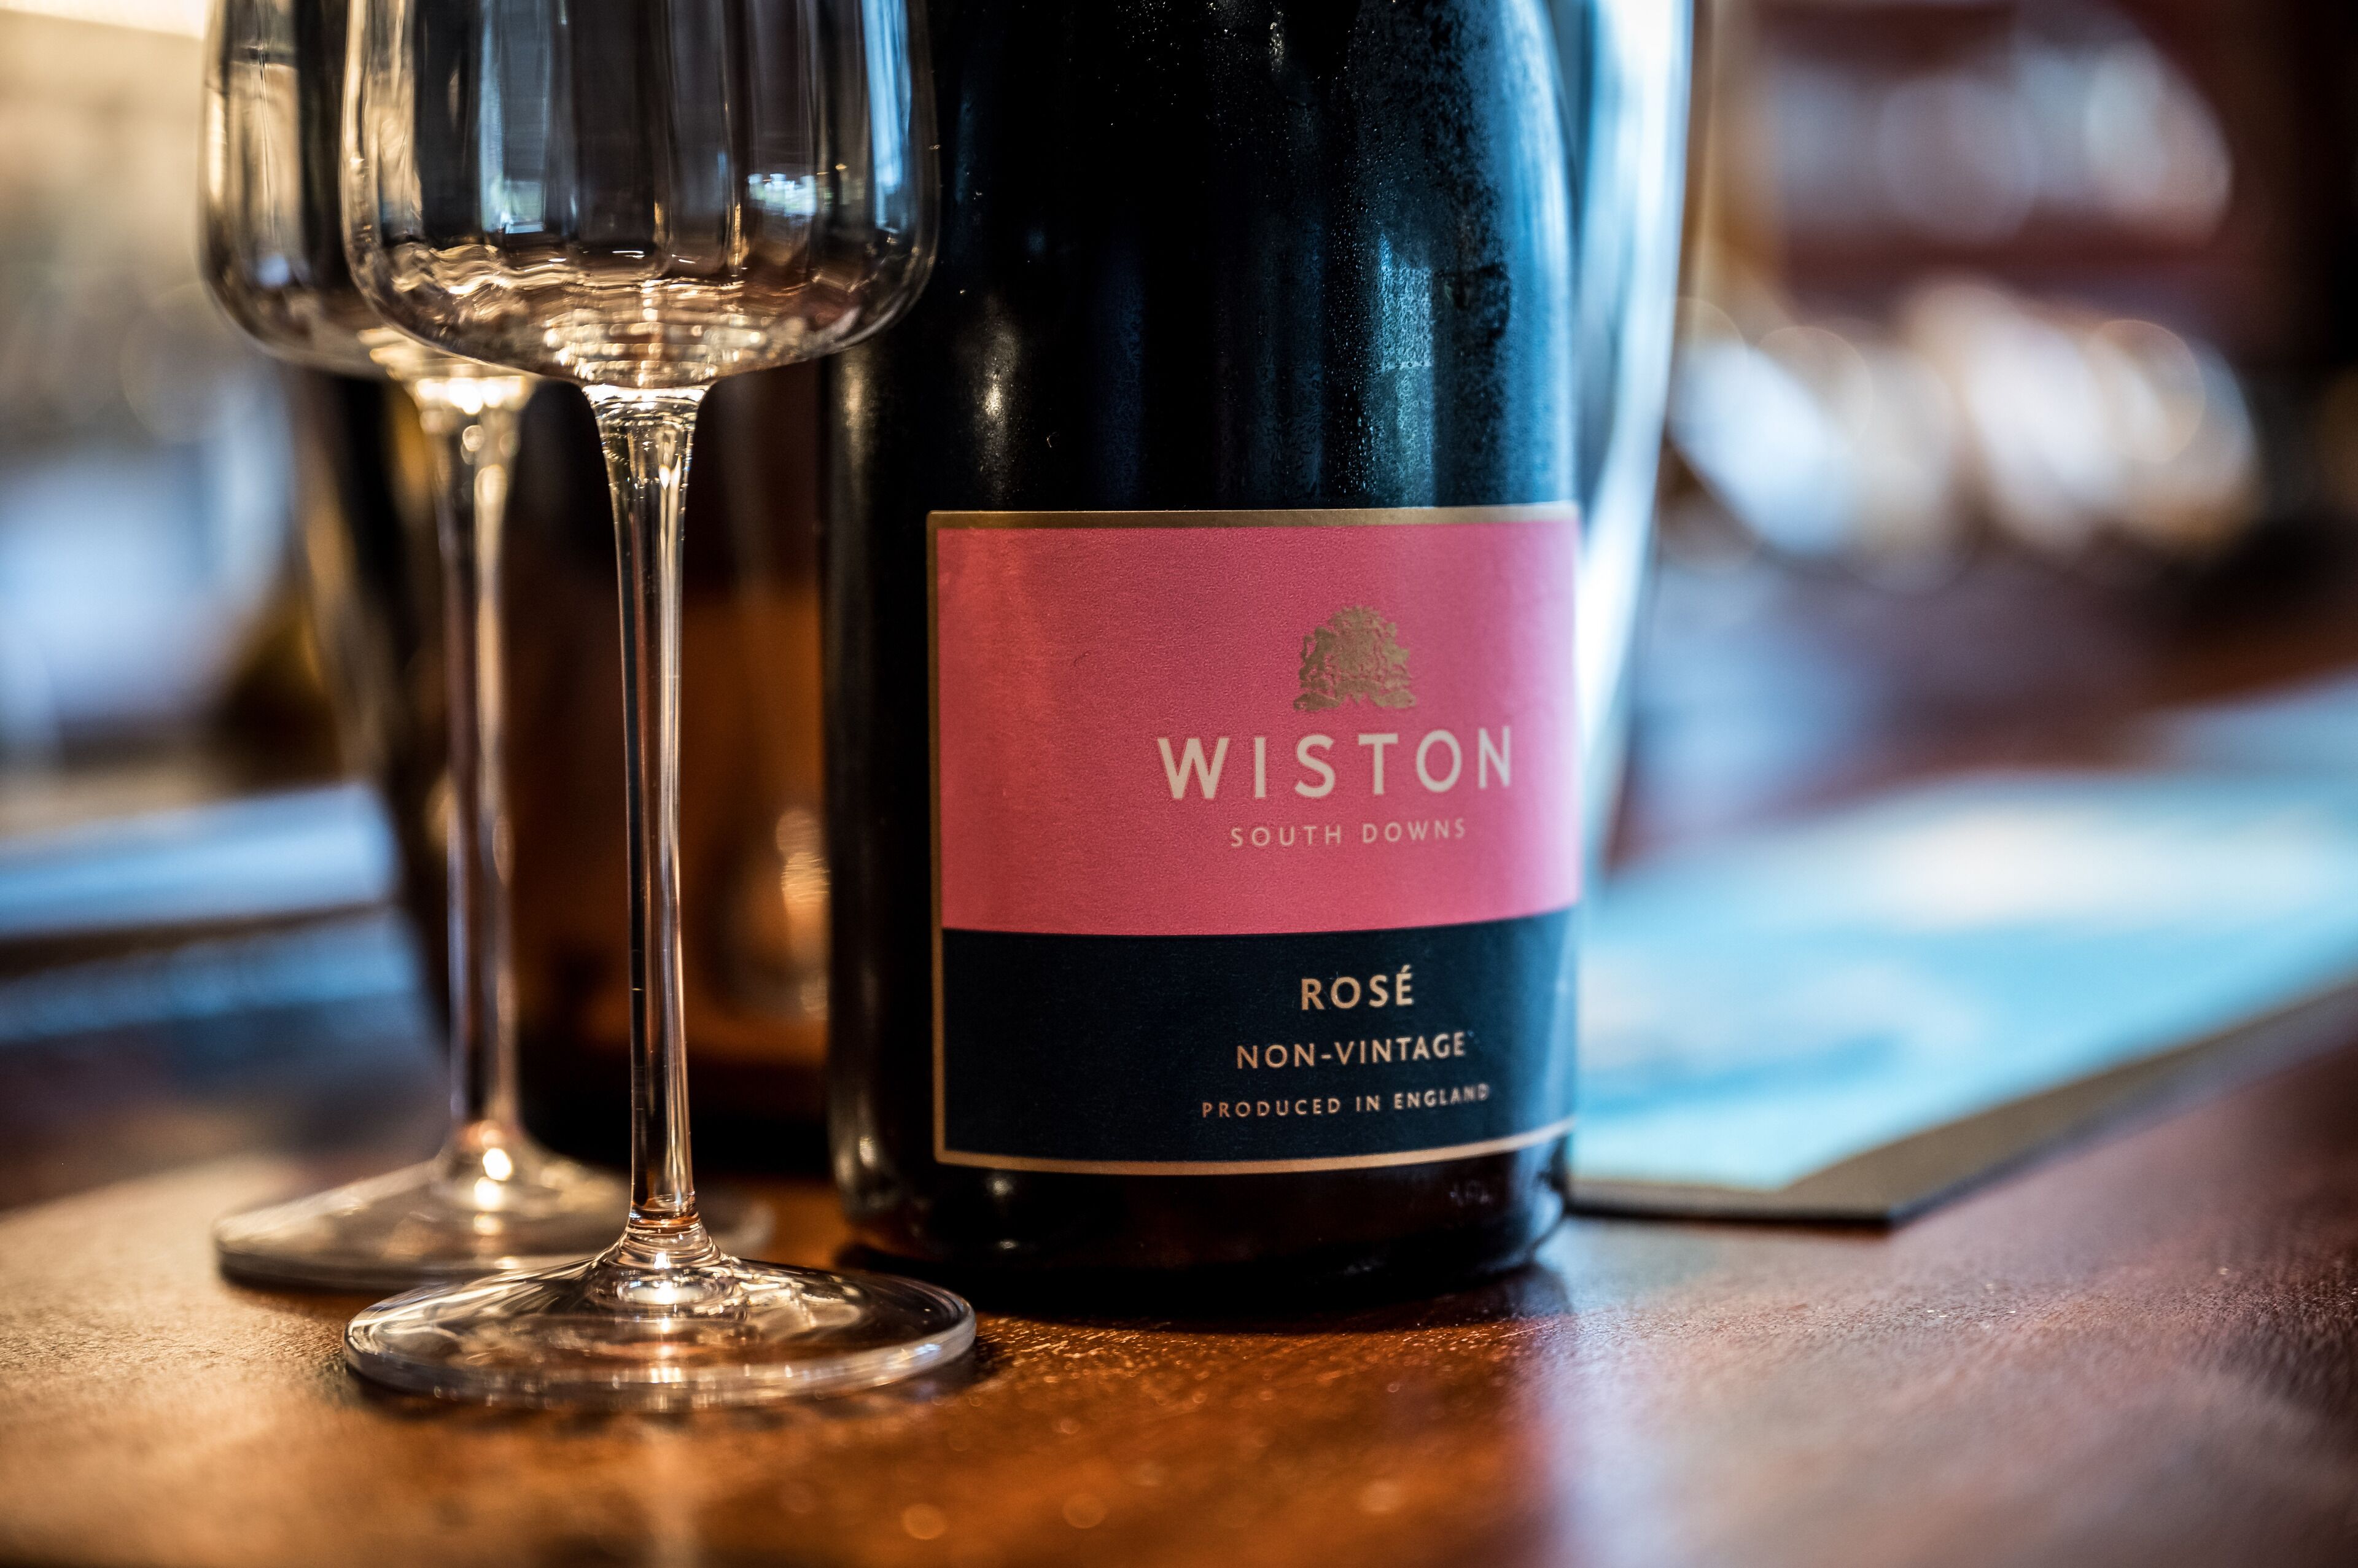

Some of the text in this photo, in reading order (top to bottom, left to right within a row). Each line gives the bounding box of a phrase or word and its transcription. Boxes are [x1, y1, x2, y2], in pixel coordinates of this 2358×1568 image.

[1157, 726, 1511, 799] WISTON
[1230, 818, 1466, 847] SOUTH DOWNS
[1301, 964, 1414, 1011] ROSÉ
[1235, 1031, 1466, 1069] NON-VINTAGE
[1202, 1082, 1490, 1119] PRODUCED IN ENGLAND
